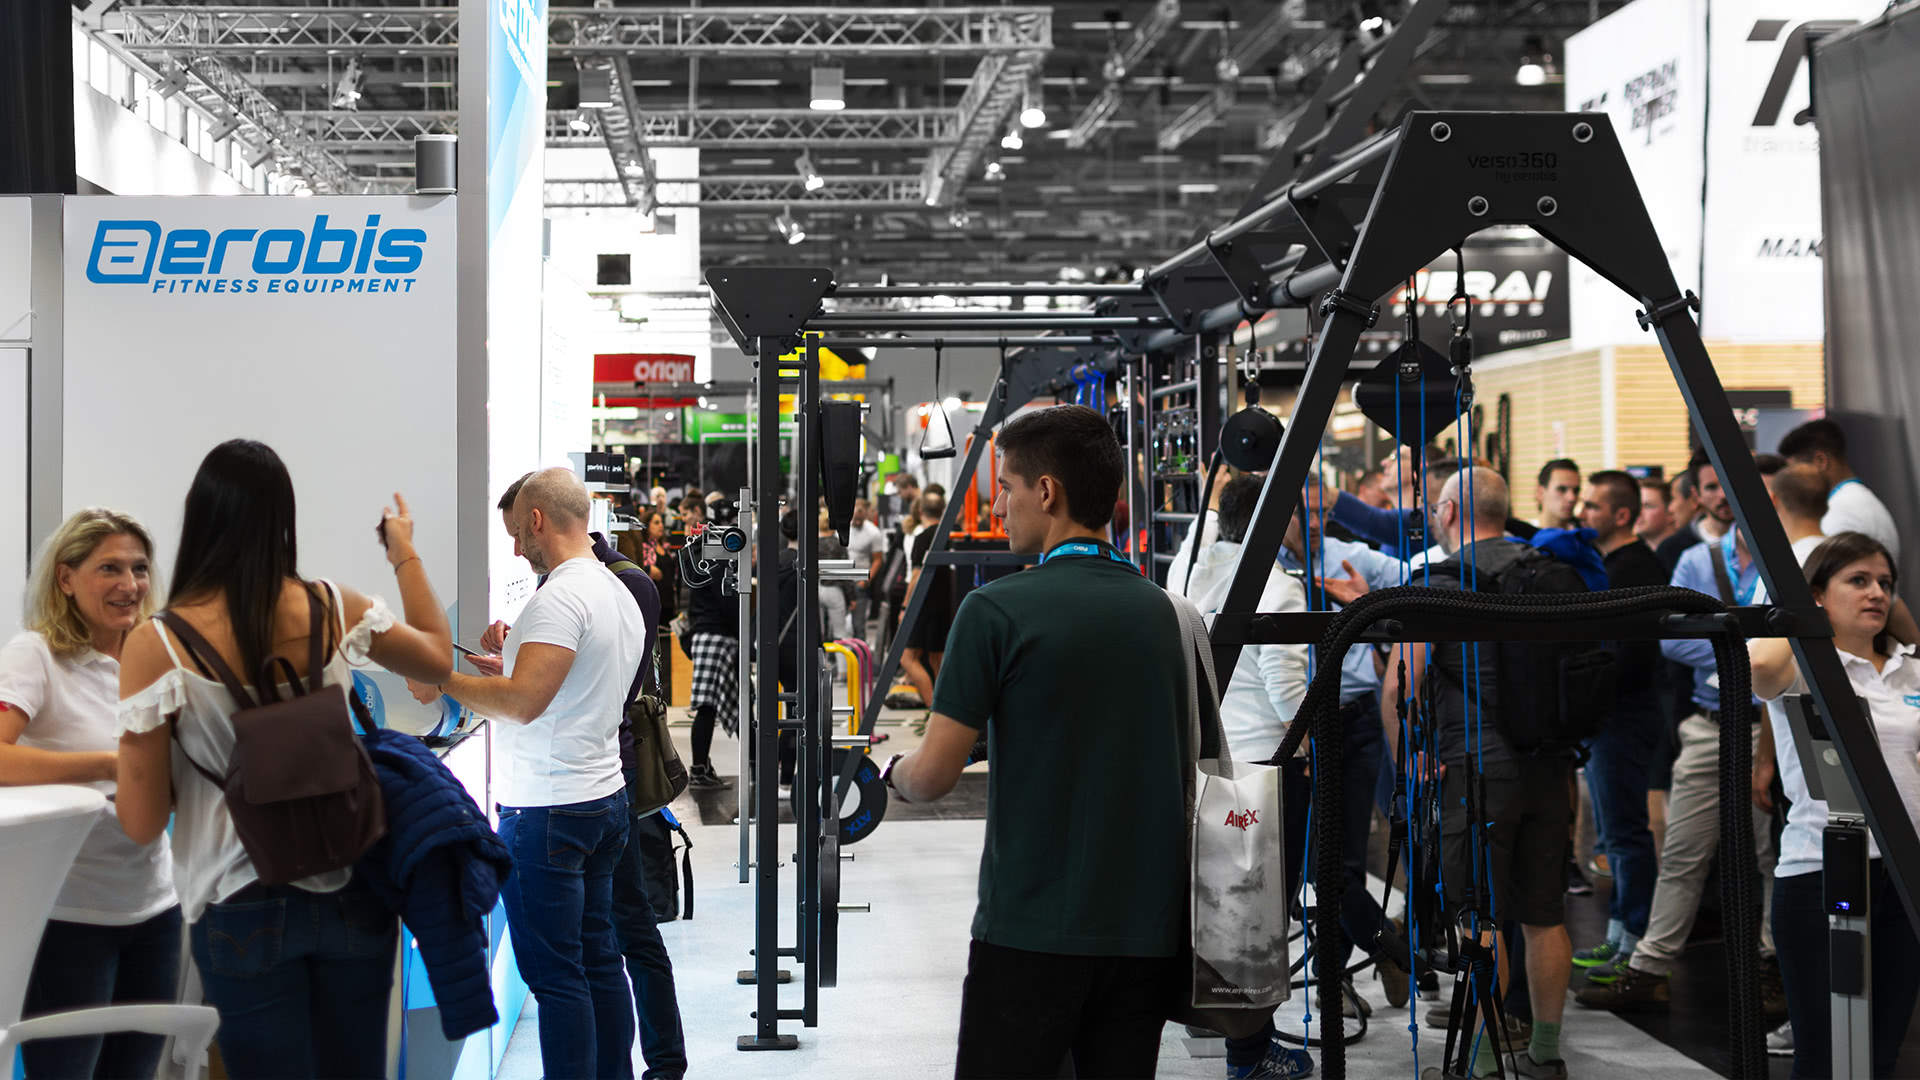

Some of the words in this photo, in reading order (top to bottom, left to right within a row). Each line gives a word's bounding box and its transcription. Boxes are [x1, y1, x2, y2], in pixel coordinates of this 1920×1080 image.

[1468, 152, 1557, 168] verso360
[86, 214, 427, 284] aerobis
[152, 278, 259, 294] FITNESS
[267, 278, 417, 294] EQUIPMENT
[1224, 808, 1259, 831] AIREX
